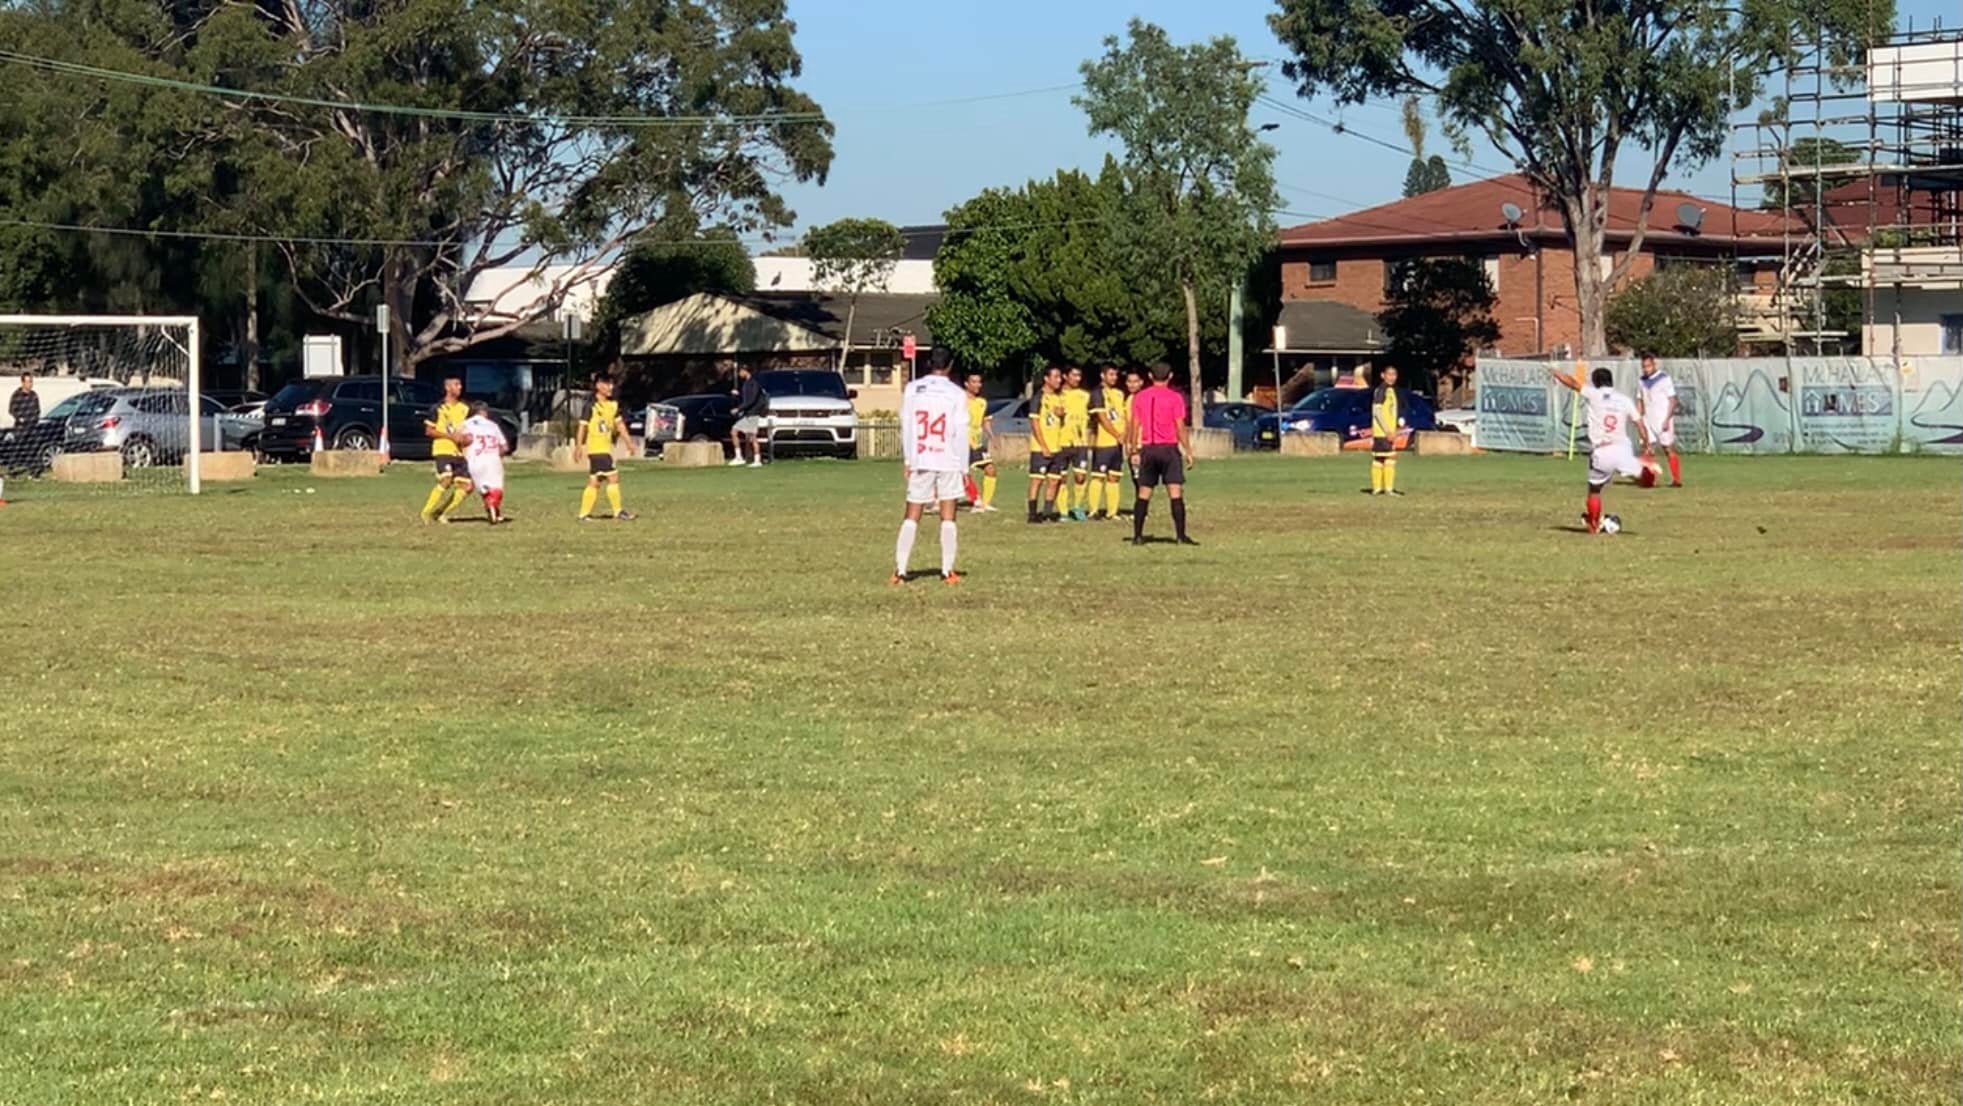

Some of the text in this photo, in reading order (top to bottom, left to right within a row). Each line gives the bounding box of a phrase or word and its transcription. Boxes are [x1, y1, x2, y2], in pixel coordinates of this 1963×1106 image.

[915, 410, 946, 443] 34
[1603, 415, 1618, 433] 9
[475, 434, 498, 450] 33
